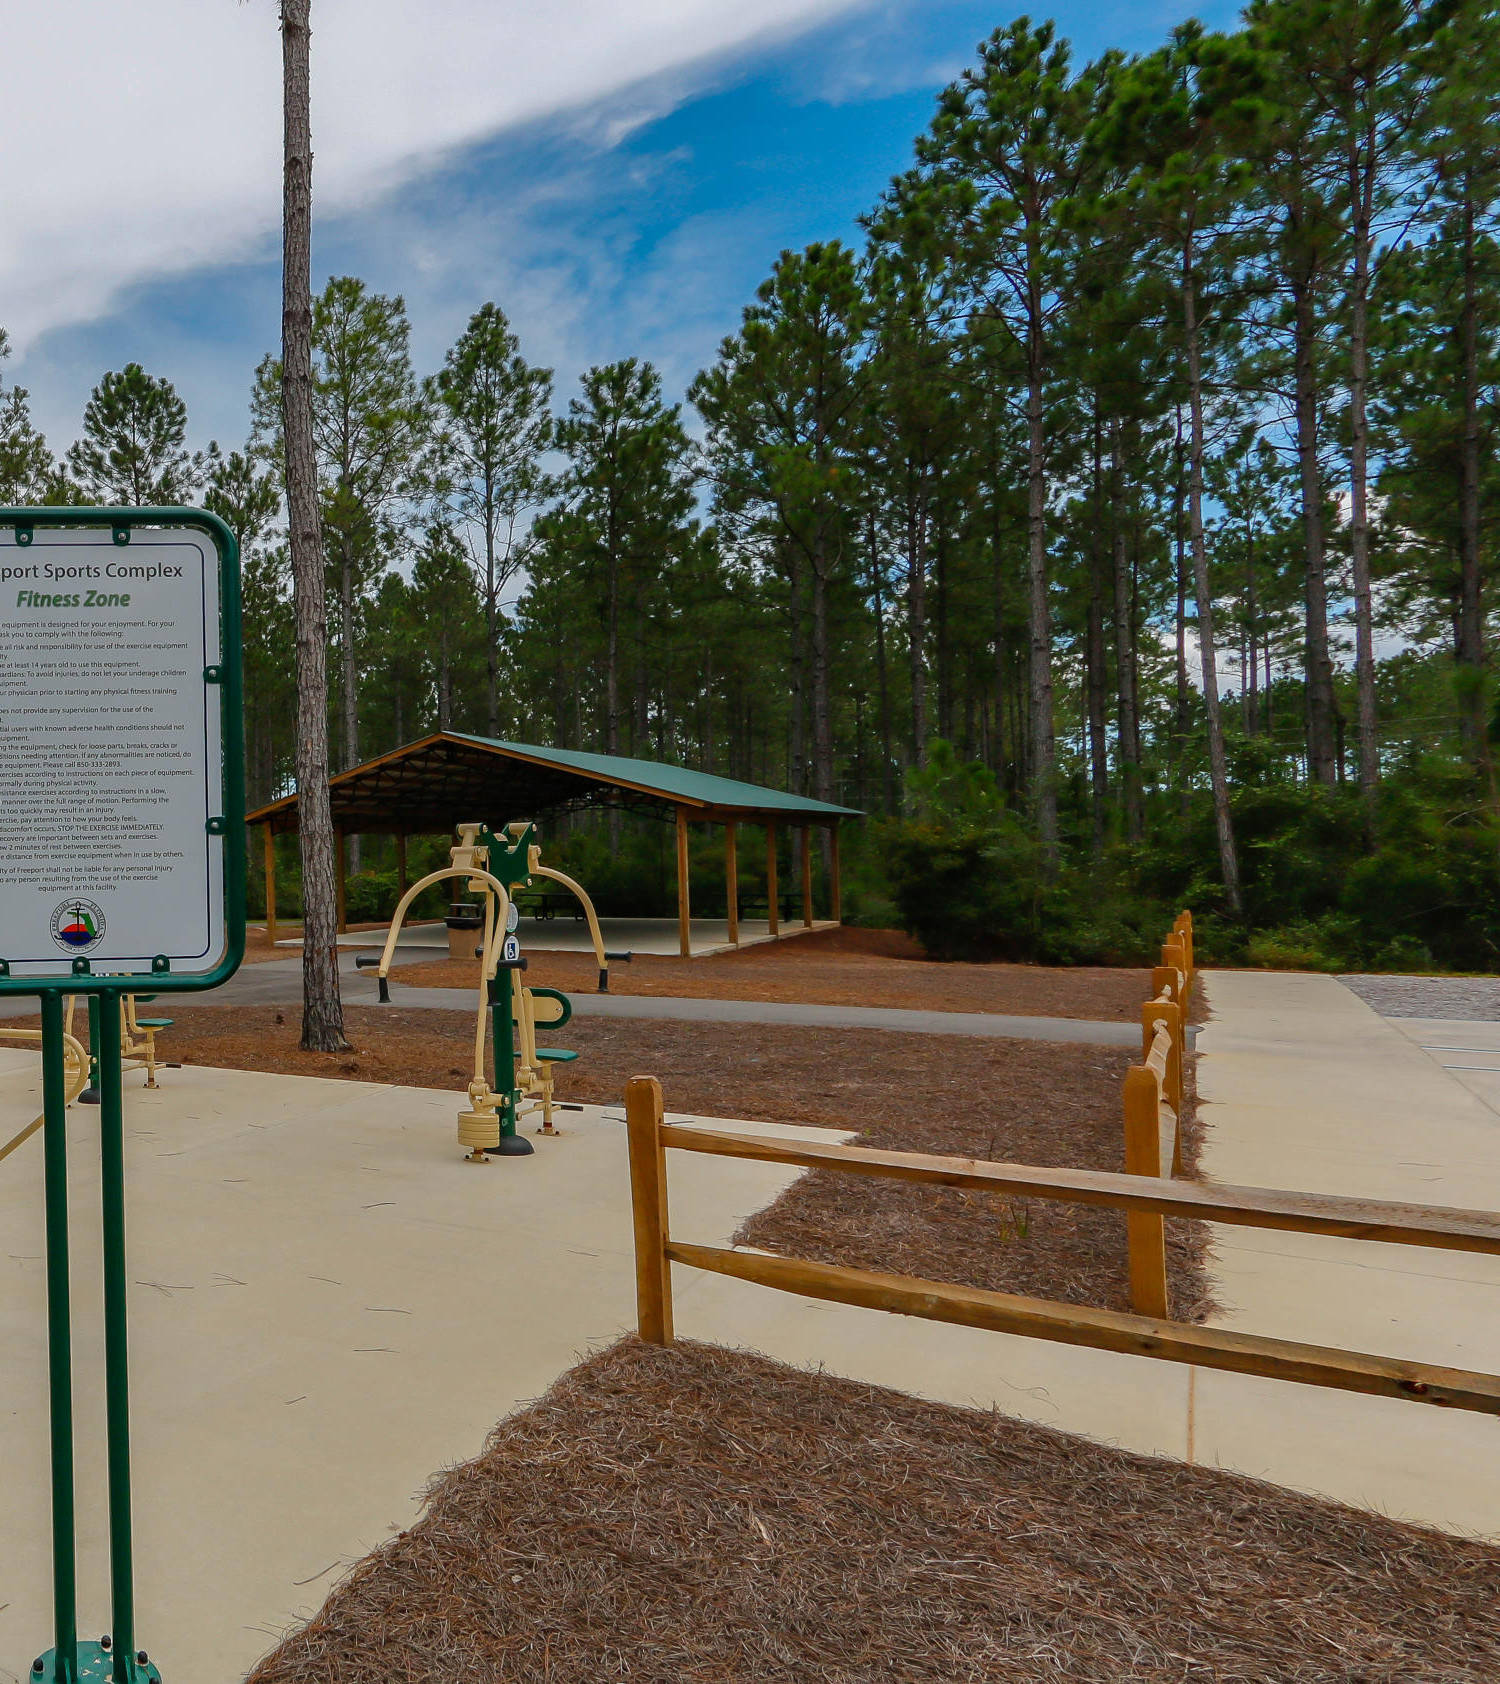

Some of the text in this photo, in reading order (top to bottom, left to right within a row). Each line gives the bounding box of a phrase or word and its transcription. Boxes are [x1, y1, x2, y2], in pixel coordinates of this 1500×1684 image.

[44, 563, 101, 582] Sports
[105, 562, 183, 581] Complex
[16, 590, 130, 608] Fitness Zone
[47, 620, 79, 629] designed
[34, 630, 60, 638] comply
[23, 707, 48, 715] provide
[24, 771, 57, 779] according
[103, 815, 121, 823] body
[17, 866, 44, 874] Freeport
